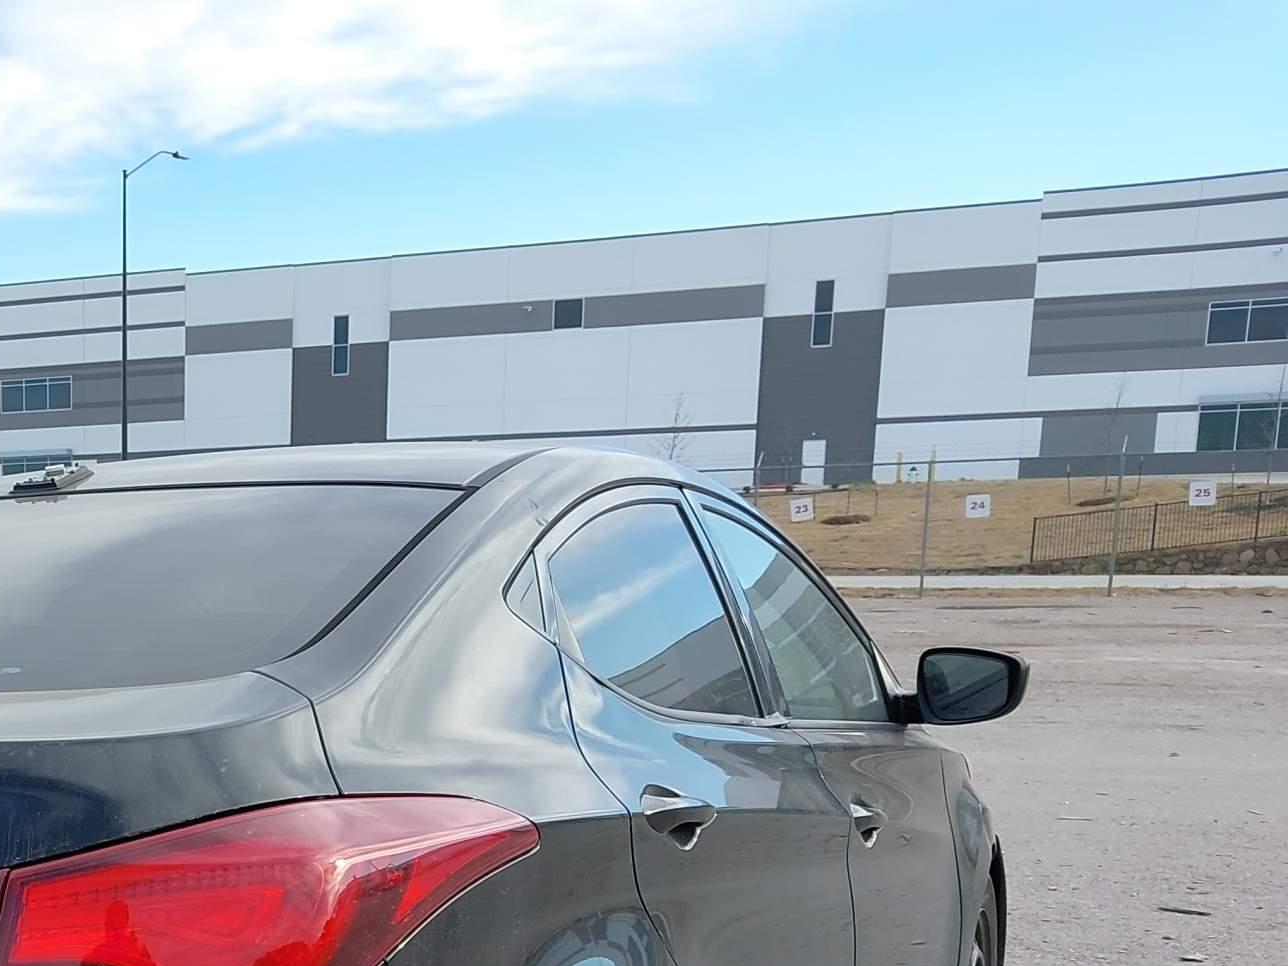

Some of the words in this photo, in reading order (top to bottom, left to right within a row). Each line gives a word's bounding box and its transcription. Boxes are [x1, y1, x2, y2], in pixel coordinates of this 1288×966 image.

[1194, 488, 1211, 498] 25
[794, 504, 809, 514] 23
[970, 501, 985, 511] 24
